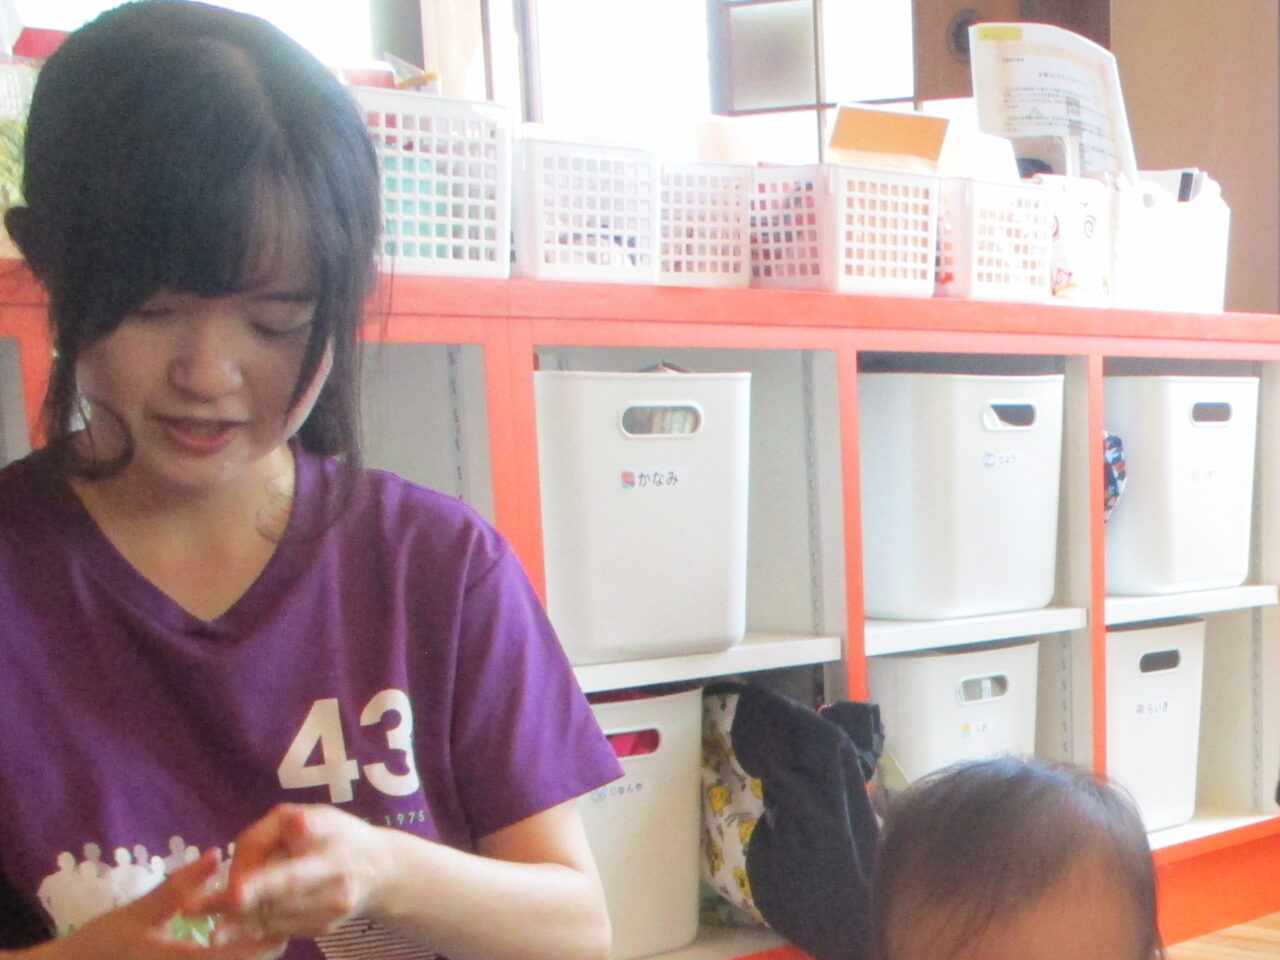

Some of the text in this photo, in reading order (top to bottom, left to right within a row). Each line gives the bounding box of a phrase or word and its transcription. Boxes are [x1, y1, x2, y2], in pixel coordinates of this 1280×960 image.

[638, 471, 679, 487] かなみ
[277, 688, 420, 804] 43
[384, 809, 426, 827] 1975
